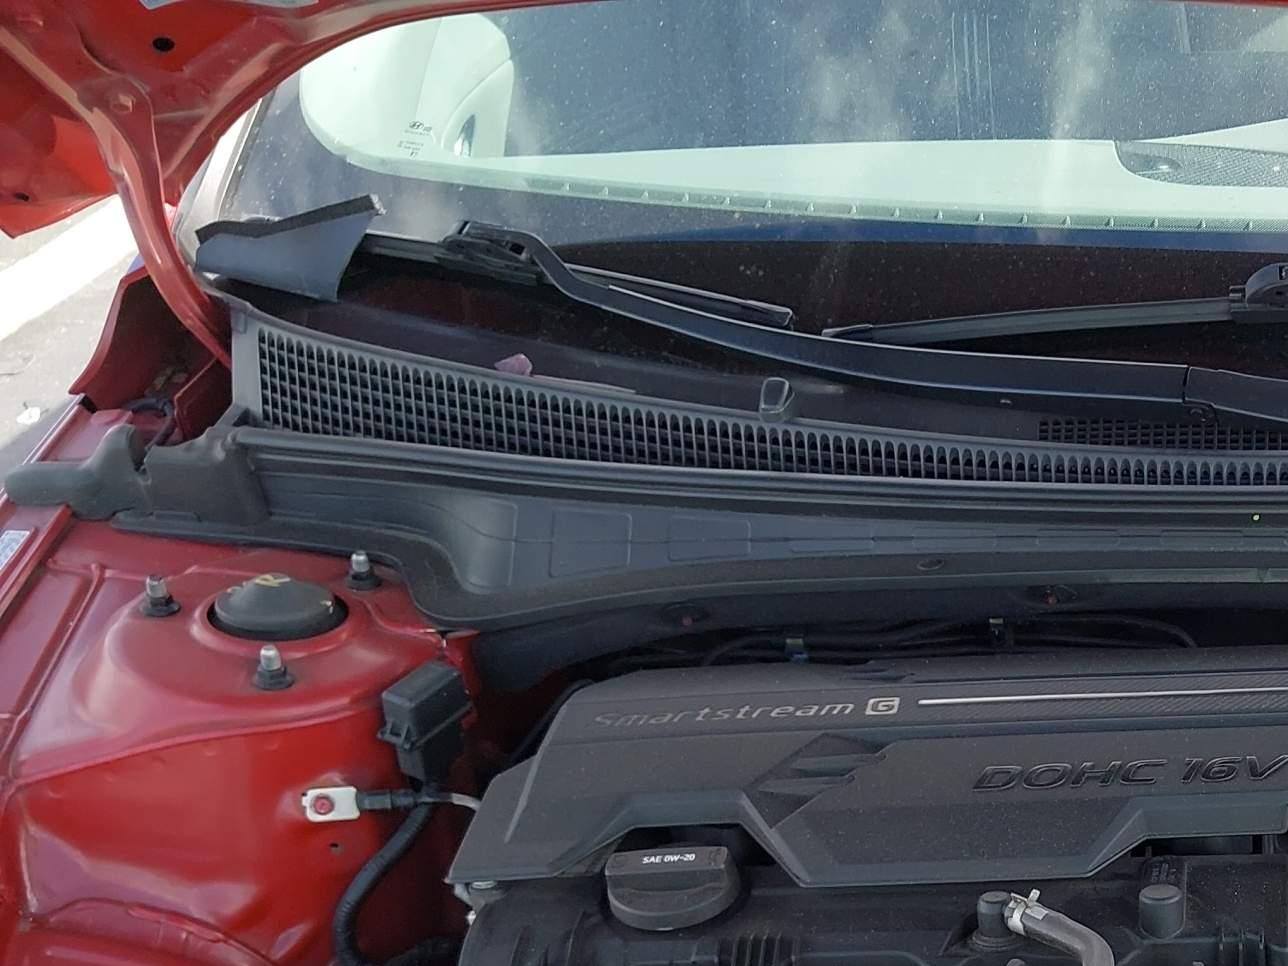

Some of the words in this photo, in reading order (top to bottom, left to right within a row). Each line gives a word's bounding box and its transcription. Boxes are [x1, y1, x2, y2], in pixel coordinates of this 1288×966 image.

[595, 703, 854, 729] Smartstream
[865, 697, 900, 716] G
[972, 758, 1168, 793] DOHC
[642, 855, 662, 865] SAE
[664, 852, 697, 864] 0W-20
